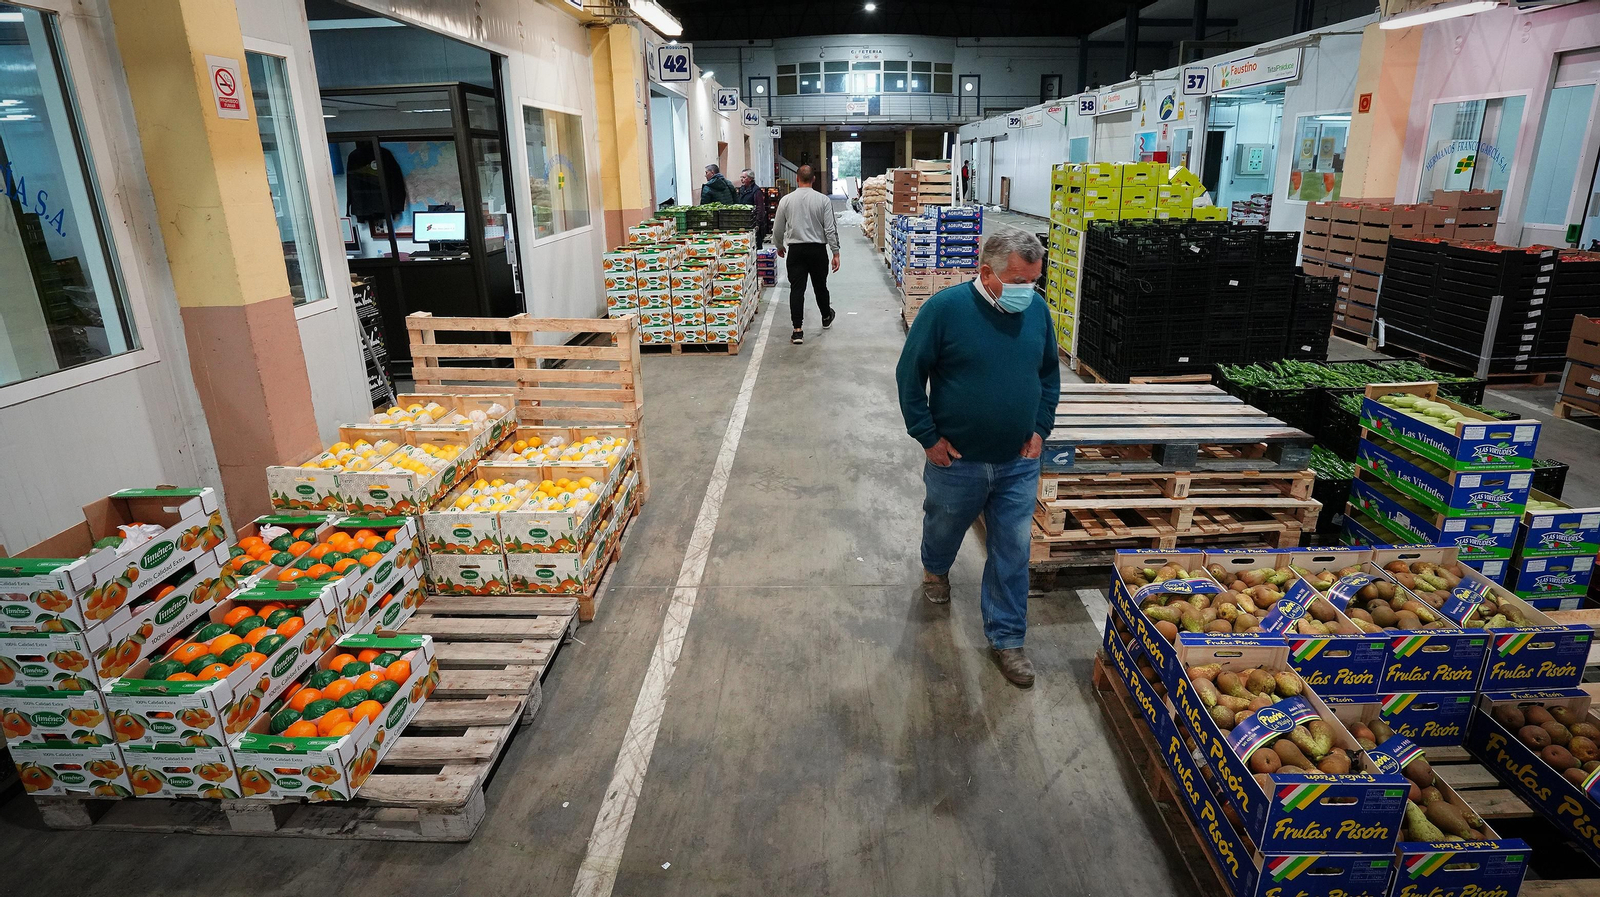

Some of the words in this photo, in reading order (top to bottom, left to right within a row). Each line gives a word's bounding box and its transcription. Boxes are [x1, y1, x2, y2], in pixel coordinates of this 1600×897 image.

[663, 55, 688, 72] 42
[1230, 62, 1258, 76] Faustino
[1187, 74, 1205, 88] 37
[720, 94, 736, 106] 43
[1080, 100, 1094, 111] 38
[745, 112, 758, 122] 44
[1010, 118, 1020, 126] 39
[1426, 142, 1455, 171] HERMANOS
[1458, 140, 1479, 152] FRANCO
[1480, 143, 1501, 162] GARCÍA
[34, 190, 66, 237] S.A.
[1402, 427, 1416, 439] Las
[1418, 432, 1451, 456] Virtudes
[1489, 448, 1512, 456] VIRTUDES
[1397, 470, 1411, 482] Las
[1413, 476, 1445, 502] Virtudes
[1484, 494, 1507, 502] VIRTUDES
[1410, 525, 1432, 544] rtudes
[1469, 538, 1492, 546] VIRTUDES
[1556, 534, 1578, 542] VIRTUDES
[144, 543, 173, 568] Jiménez
[138, 577, 152, 590] 100%
[153, 564, 173, 579] Calidad
[173, 556, 186, 566] Extra
[158, 597, 186, 624] Jiménez
[152, 632, 166, 645] 100%
[166, 618, 186, 634] Calidad
[186, 608, 198, 620] Extra
[1114, 580, 1135, 626] Frutas
[1137, 618, 1164, 669] Pisón
[274, 650, 298, 674] Jiménez
[1490, 662, 1534, 680] Frutas
[1536, 660, 1577, 678] Pisón
[281, 670, 297, 686] Calidad
[297, 659, 308, 670] Extra
[1108, 630, 1130, 678] Frutas
[1130, 670, 1157, 724] Pisón
[1334, 668, 1374, 686] Pisón
[1386, 663, 1430, 682] Frutas
[1432, 664, 1473, 681] Pisón
[35, 714, 64, 722] Jiménez
[405, 708, 416, 722] Extra
[1259, 711, 1285, 725] Pisón
[1421, 720, 1460, 738] Pisón
[1176, 678, 1209, 745] Frutas
[1210, 738, 1250, 813] Pisón
[1485, 732, 1552, 801] Frutas
[61, 774, 84, 782] Jiménez
[1304, 774, 1338, 782] Pisón
[1168, 736, 1200, 806] Frutas
[1200, 801, 1240, 879] Pisón
[1272, 818, 1332, 840] Frutas
[1334, 820, 1389, 840] Pisón
